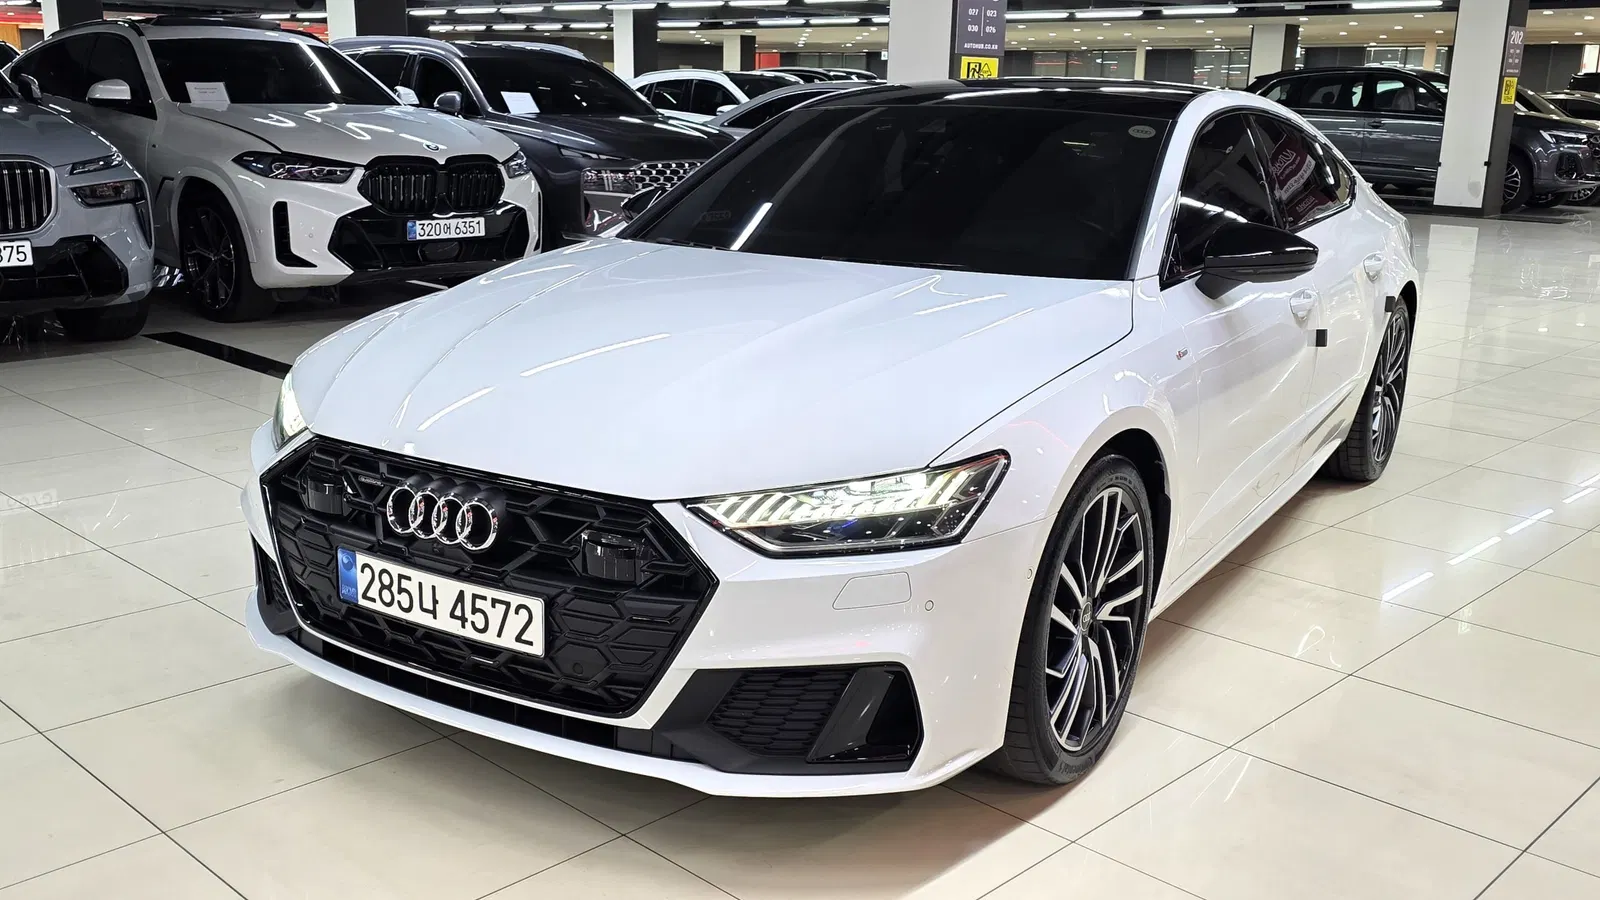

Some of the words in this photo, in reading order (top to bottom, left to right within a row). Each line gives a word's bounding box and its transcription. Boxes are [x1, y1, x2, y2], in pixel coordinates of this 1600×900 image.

[968, 8, 979, 16] 027
[986, 9, 997, 17] 023
[967, 24, 979, 32] 030
[985, 25, 997, 33] 026
[1510, 30, 1524, 44] 202
[963, 42, 998, 50] AUTOHUB.CO.KR
[418, 222, 451, 237] 320어
[454, 220, 481, 235] 6351
[360, 562, 439, 620] 285나
[449, 589, 534, 647] 4572
